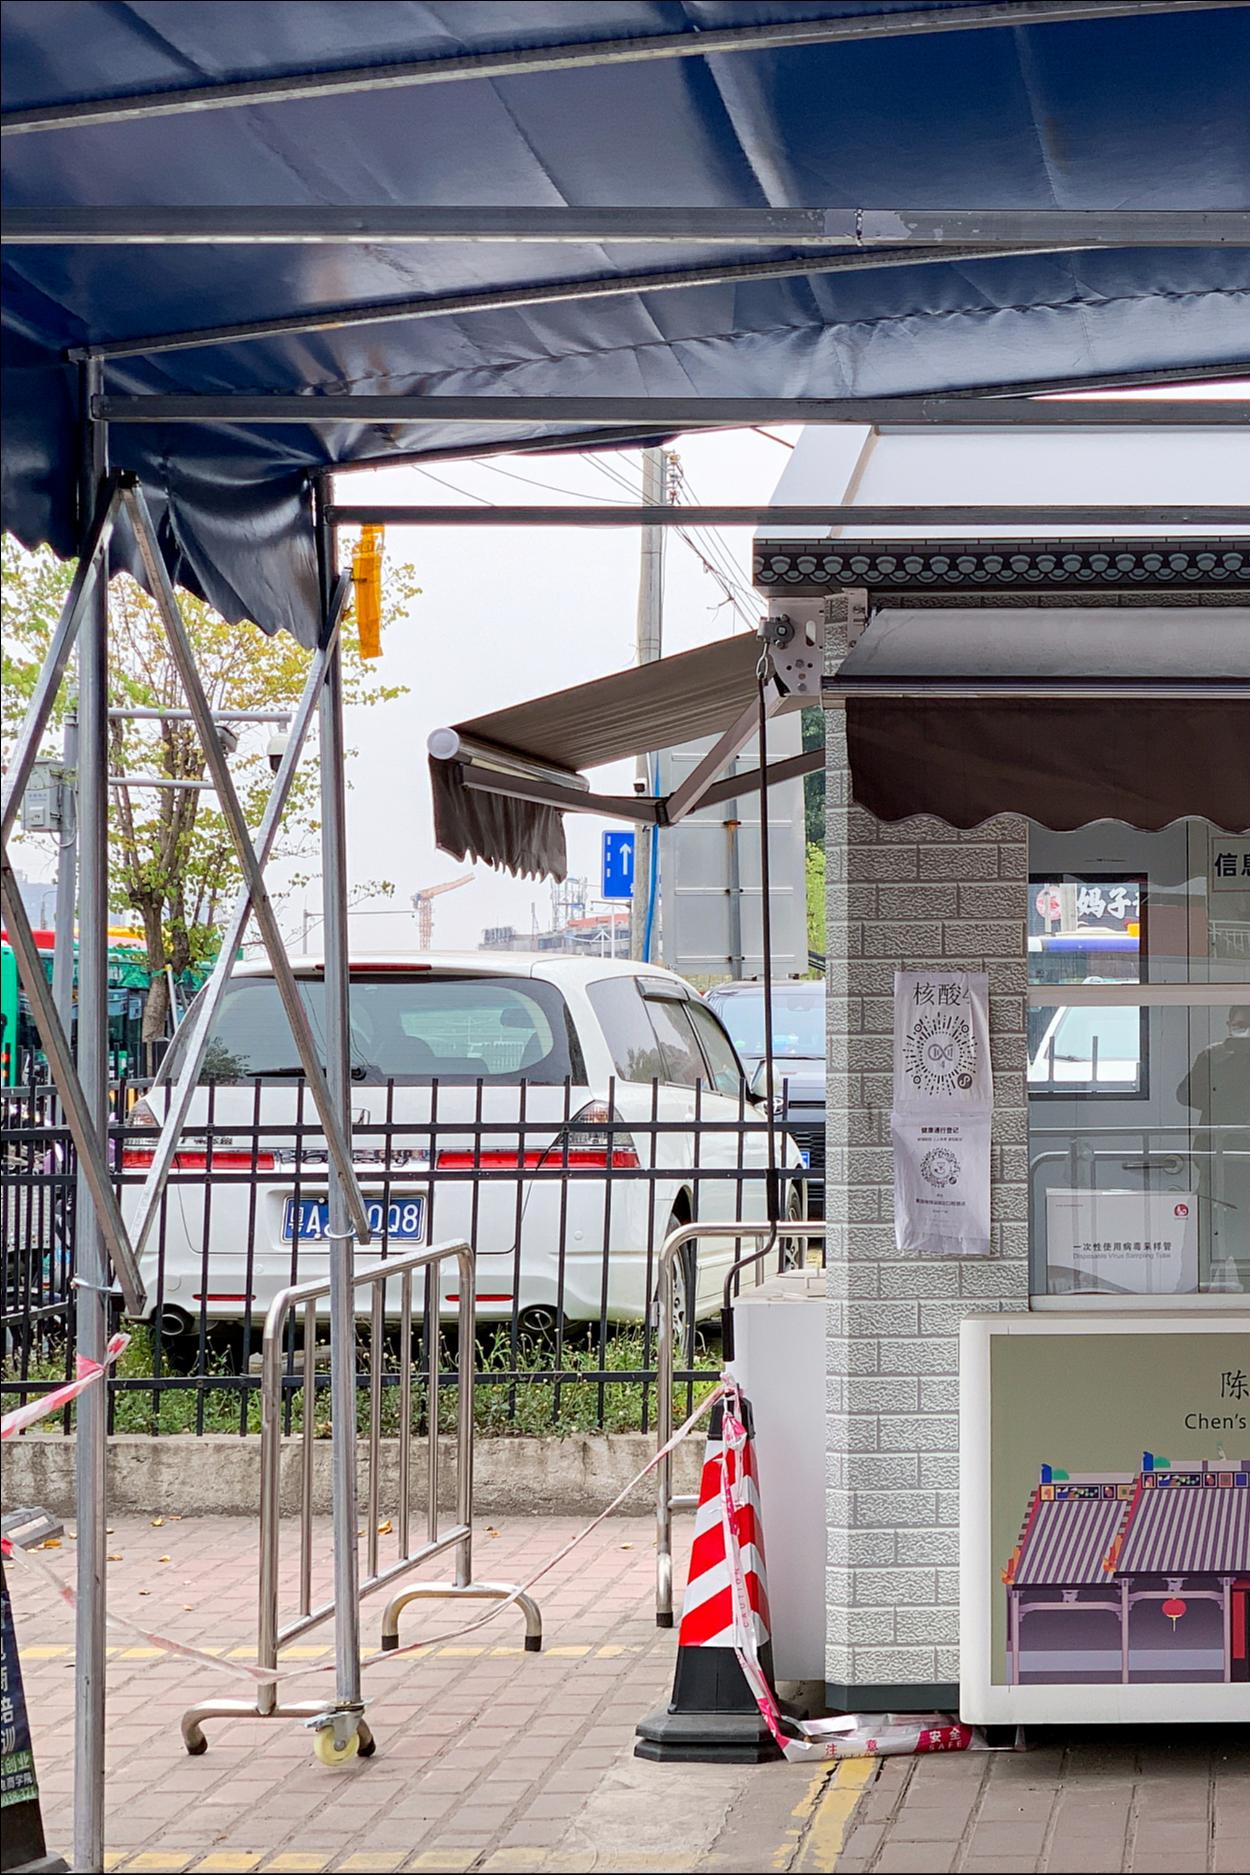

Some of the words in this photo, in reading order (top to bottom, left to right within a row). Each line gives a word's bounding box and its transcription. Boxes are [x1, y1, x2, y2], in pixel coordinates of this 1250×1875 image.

[288, 1203, 419, 1234] 粤AQQ8
[1184, 1412, 1248, 1430] Chen's
[928, 1727, 962, 1745] 安全
